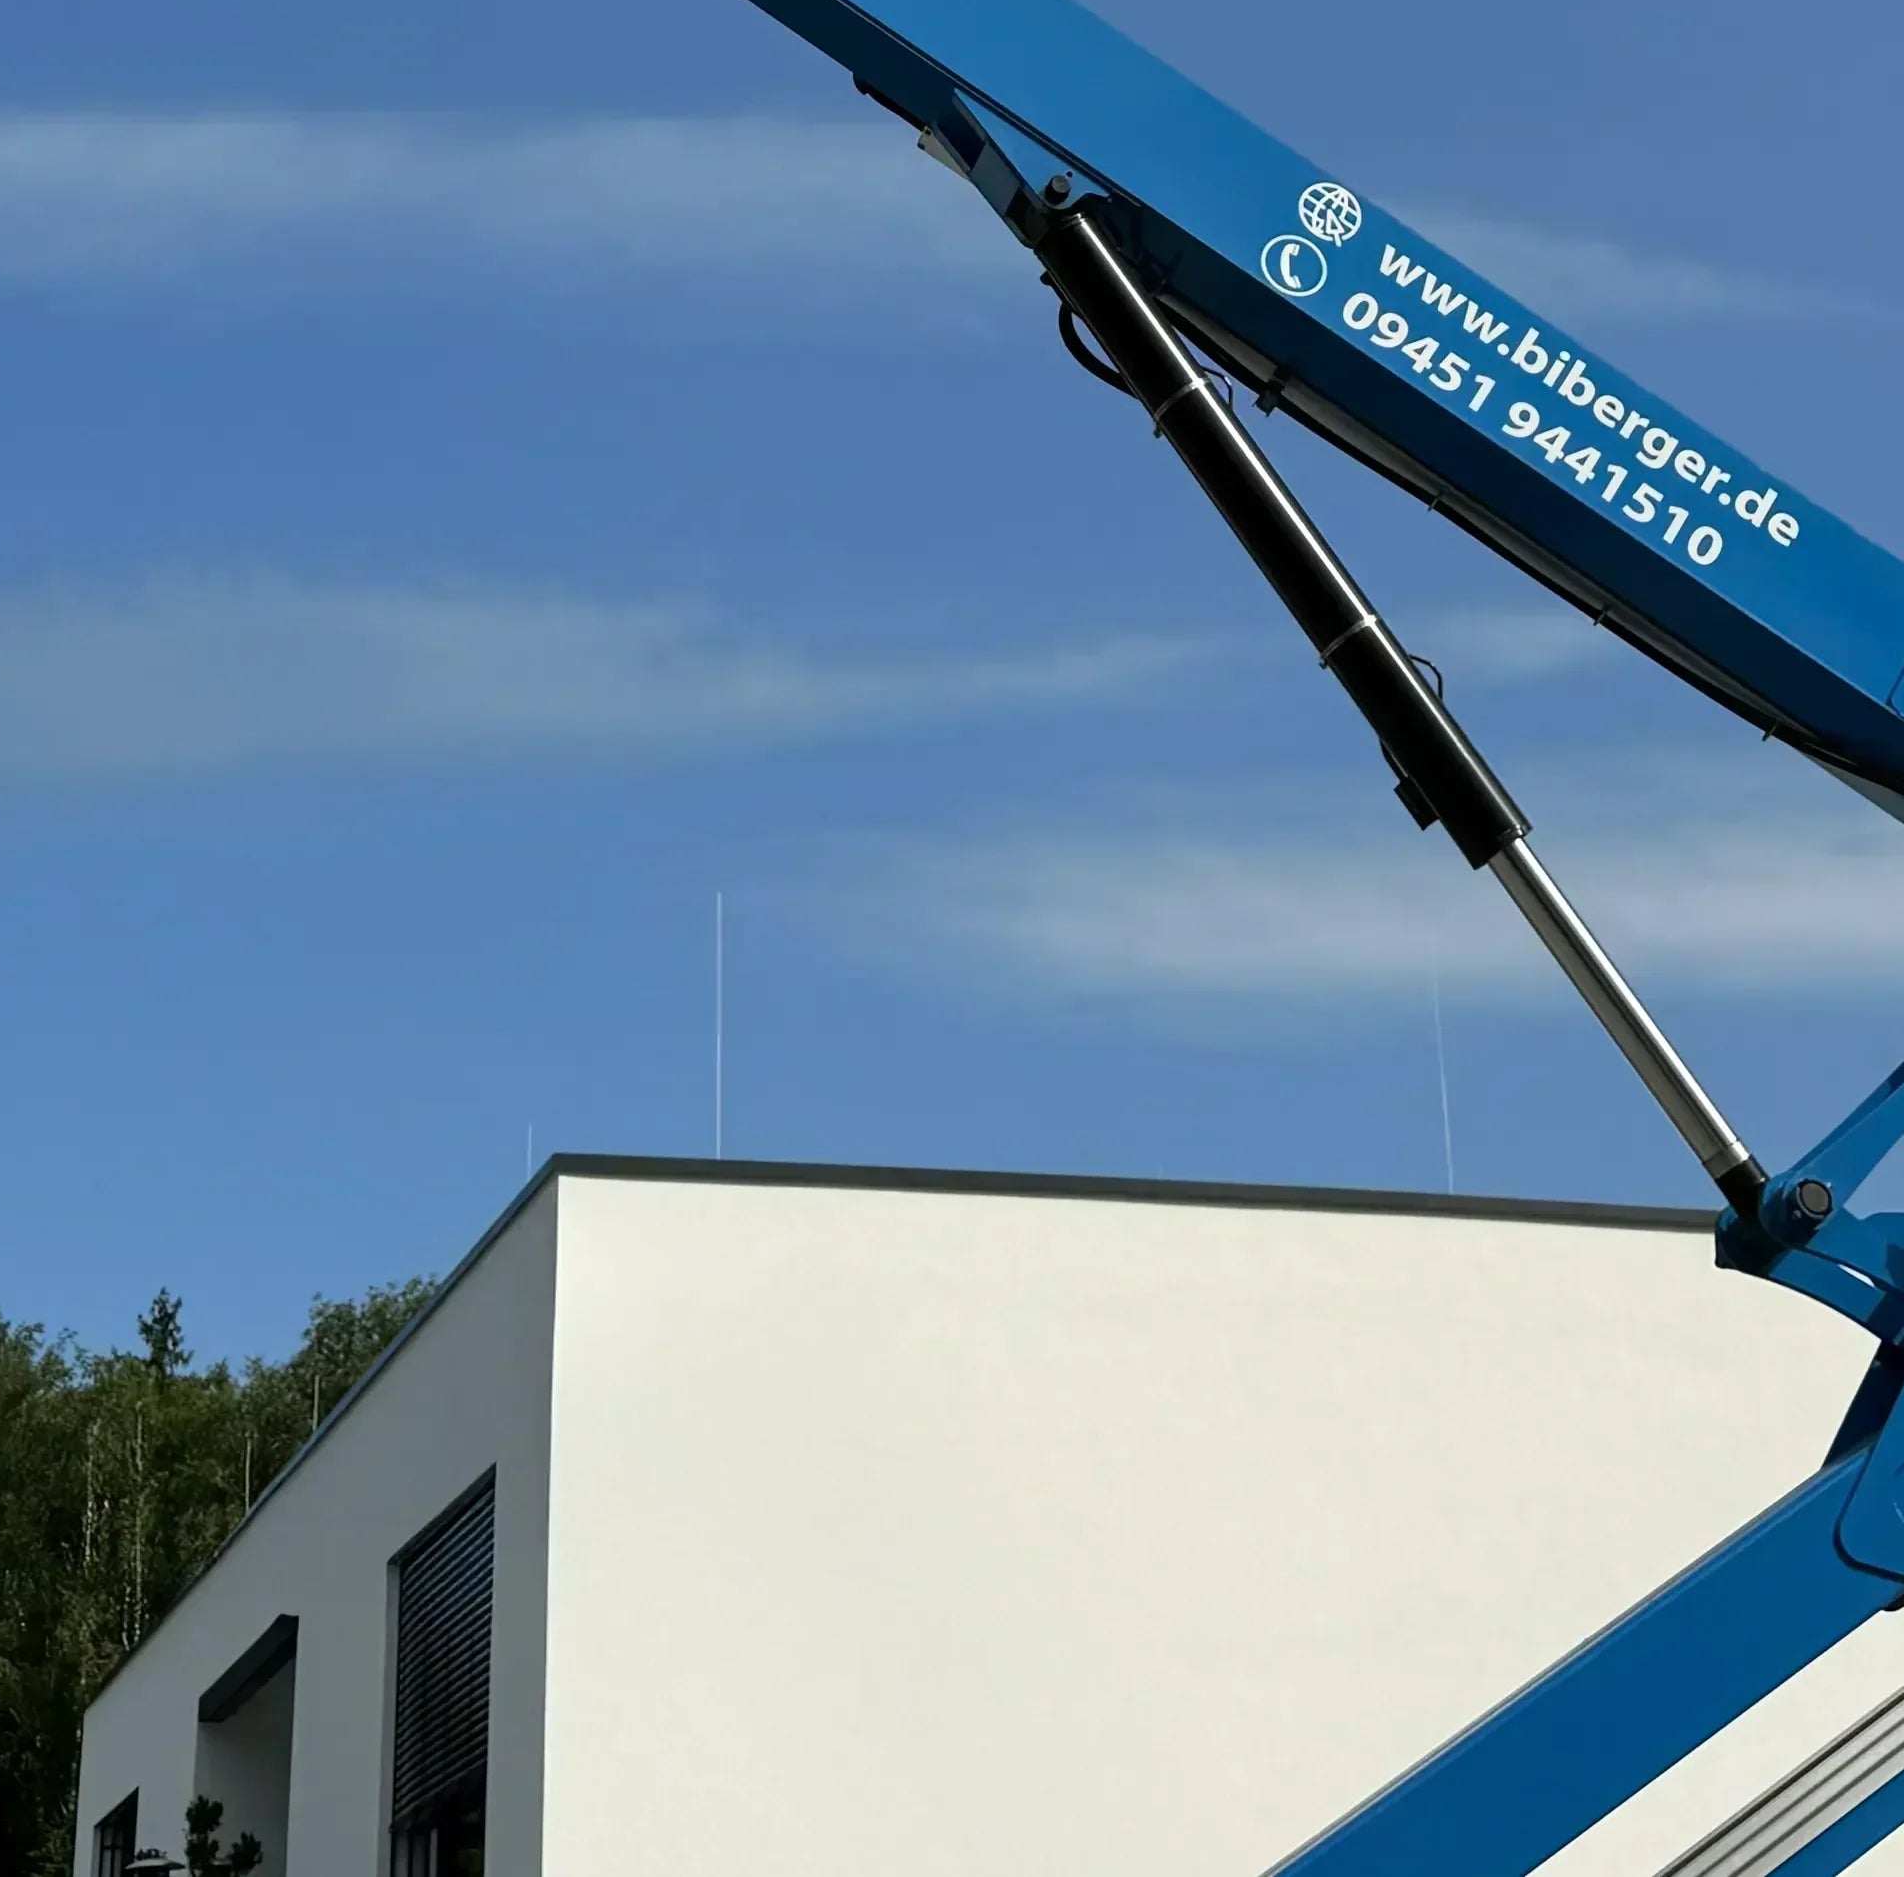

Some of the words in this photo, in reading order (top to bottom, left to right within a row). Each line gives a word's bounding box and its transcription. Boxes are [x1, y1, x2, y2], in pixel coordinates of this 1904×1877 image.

[1342, 292, 1496, 412] 09451
[1502, 401, 1723, 565] 9441510
[1379, 244, 1799, 546] www.biberger.de
